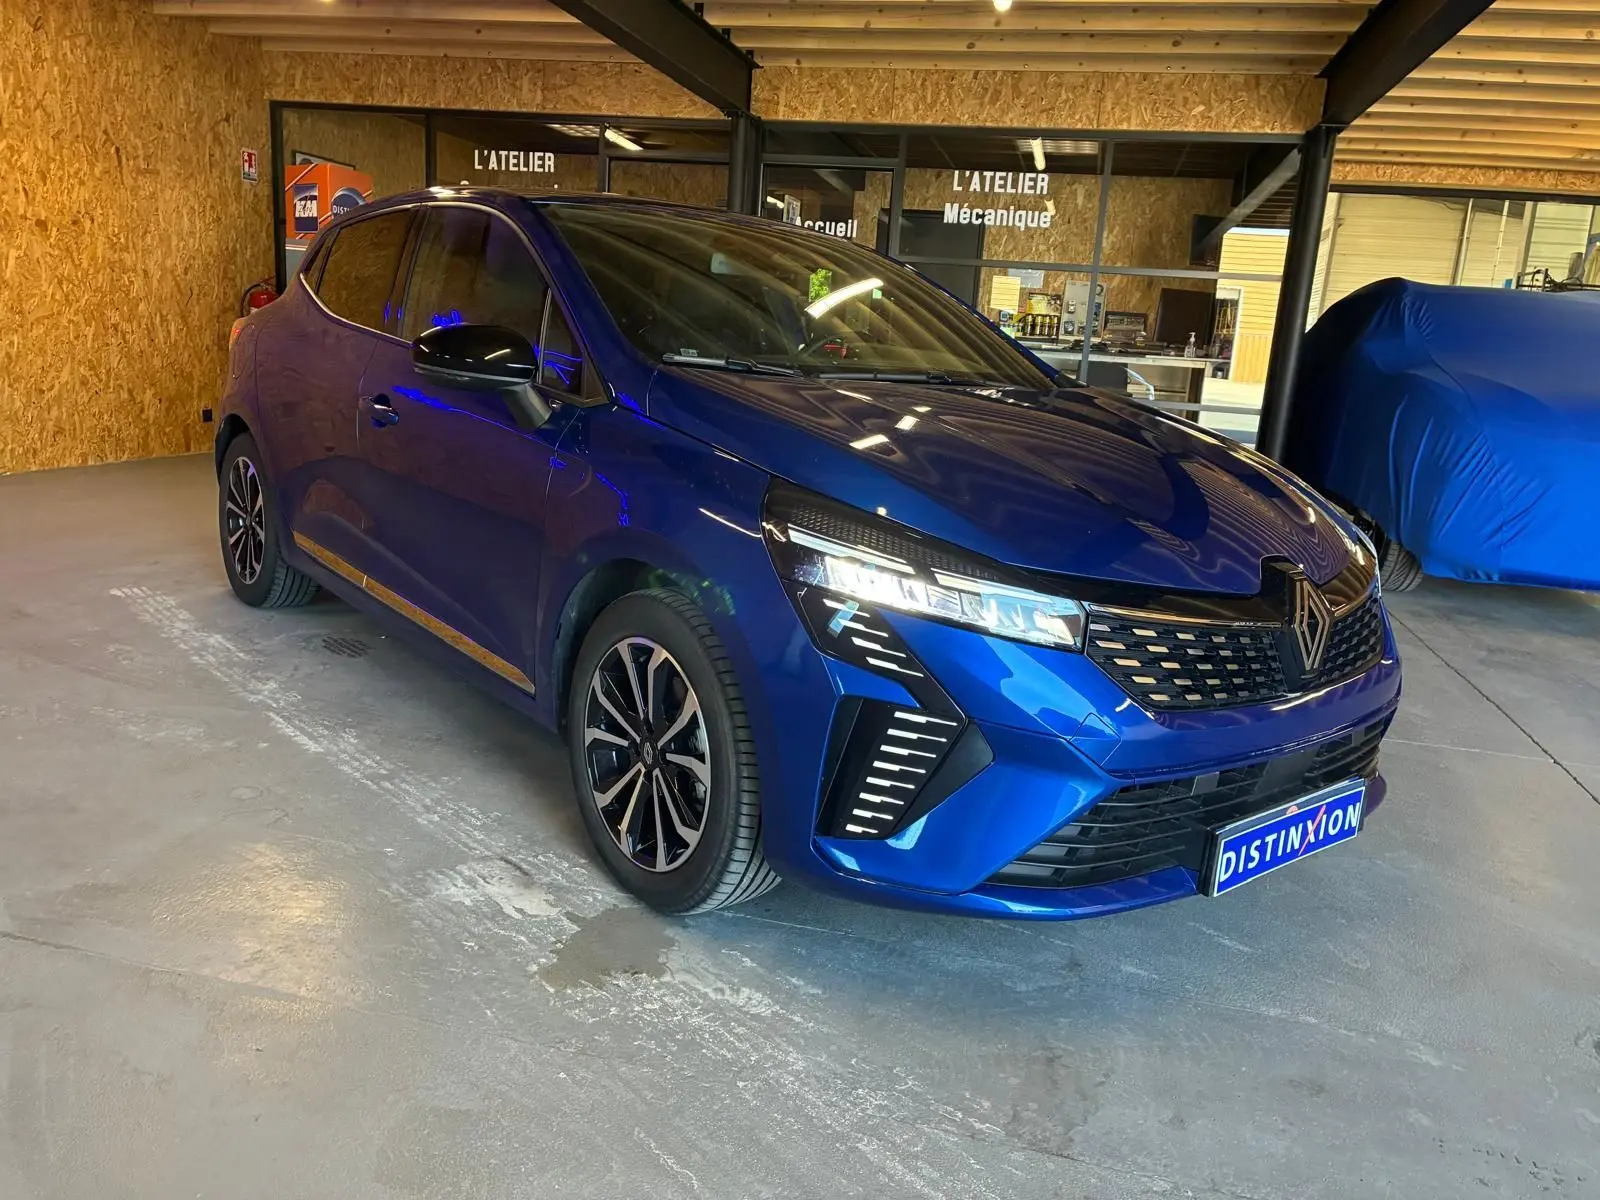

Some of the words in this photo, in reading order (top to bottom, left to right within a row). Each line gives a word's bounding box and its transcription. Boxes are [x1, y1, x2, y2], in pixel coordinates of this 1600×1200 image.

[474, 149, 555, 173] L'ATELIER
[952, 170, 1049, 195] L'ATELIER
[332, 204, 350, 215] DIST
[943, 202, 1052, 231] Mécanique
[1219, 802, 1361, 883] DISTINXION
